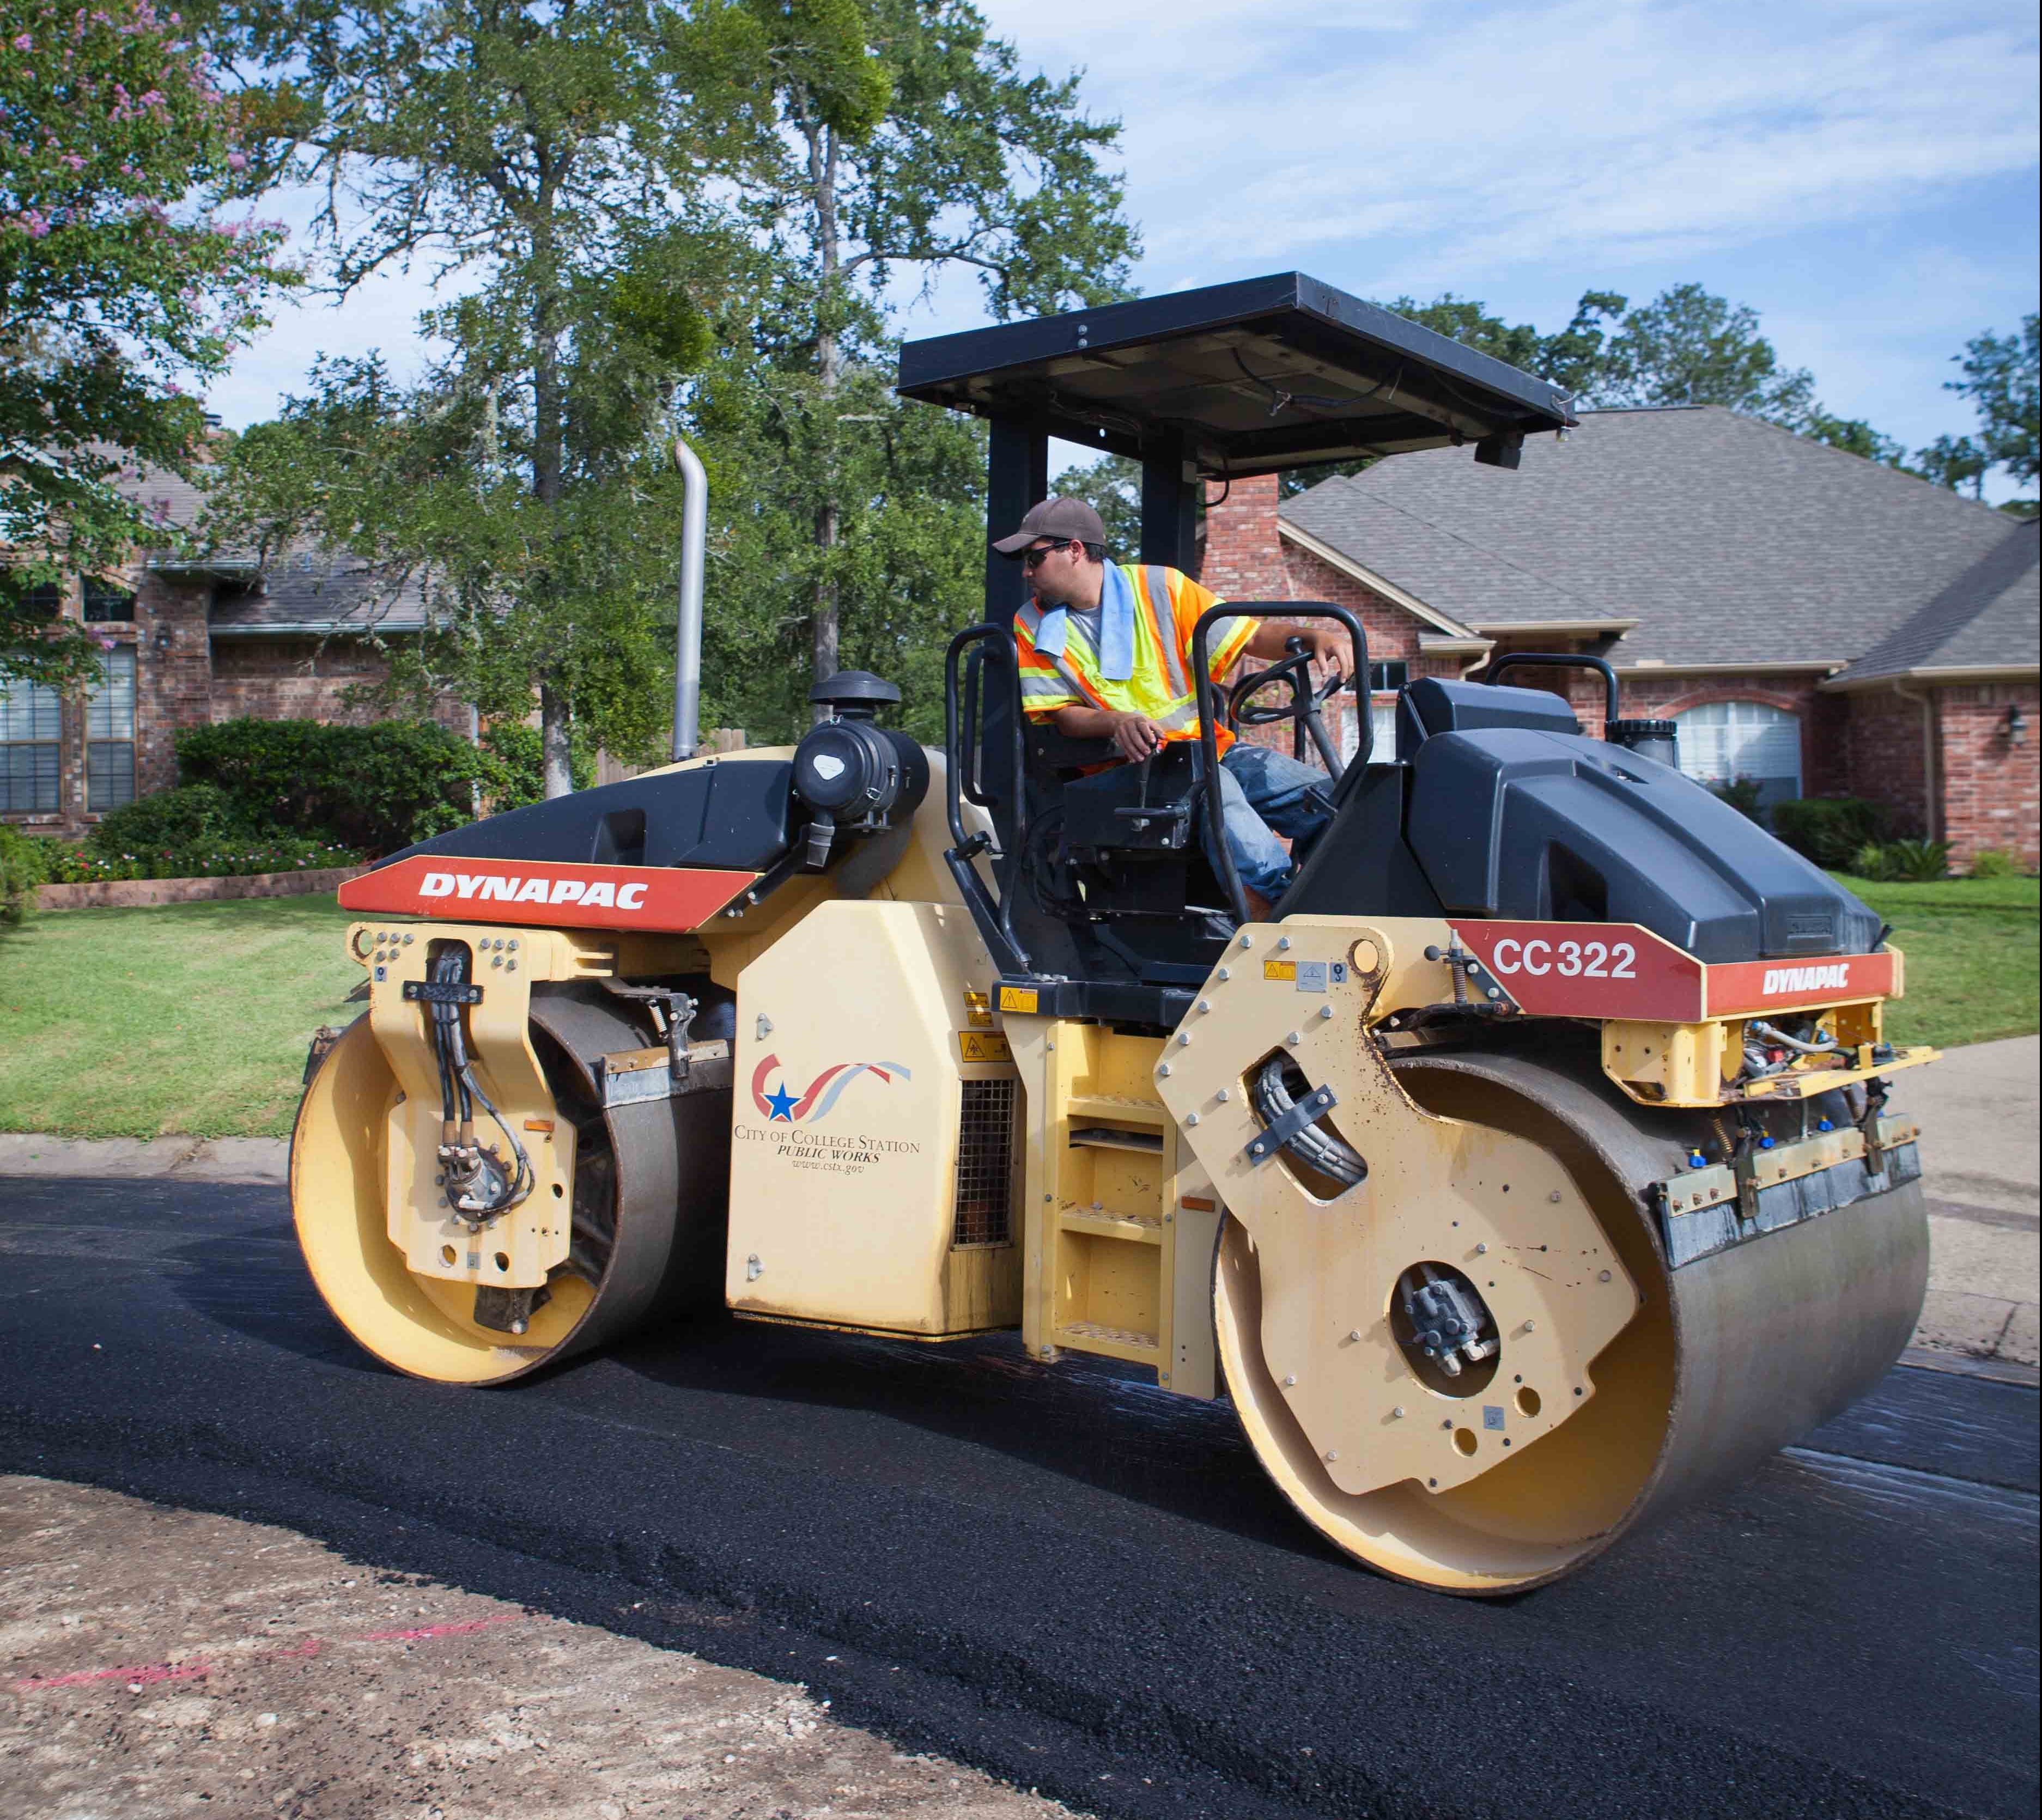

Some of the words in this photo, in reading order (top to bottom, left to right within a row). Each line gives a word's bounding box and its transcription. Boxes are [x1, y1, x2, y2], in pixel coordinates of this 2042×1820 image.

[419, 873, 648, 909] DYNAPAC
[1493, 939, 1636, 978] CC322
[1763, 963, 1849, 995] DYNAPAC
[777, 1145, 827, 1159] PUBLIC
[832, 1150, 880, 1164] WORKS
[792, 1160, 865, 1175] www.cstx.gov
